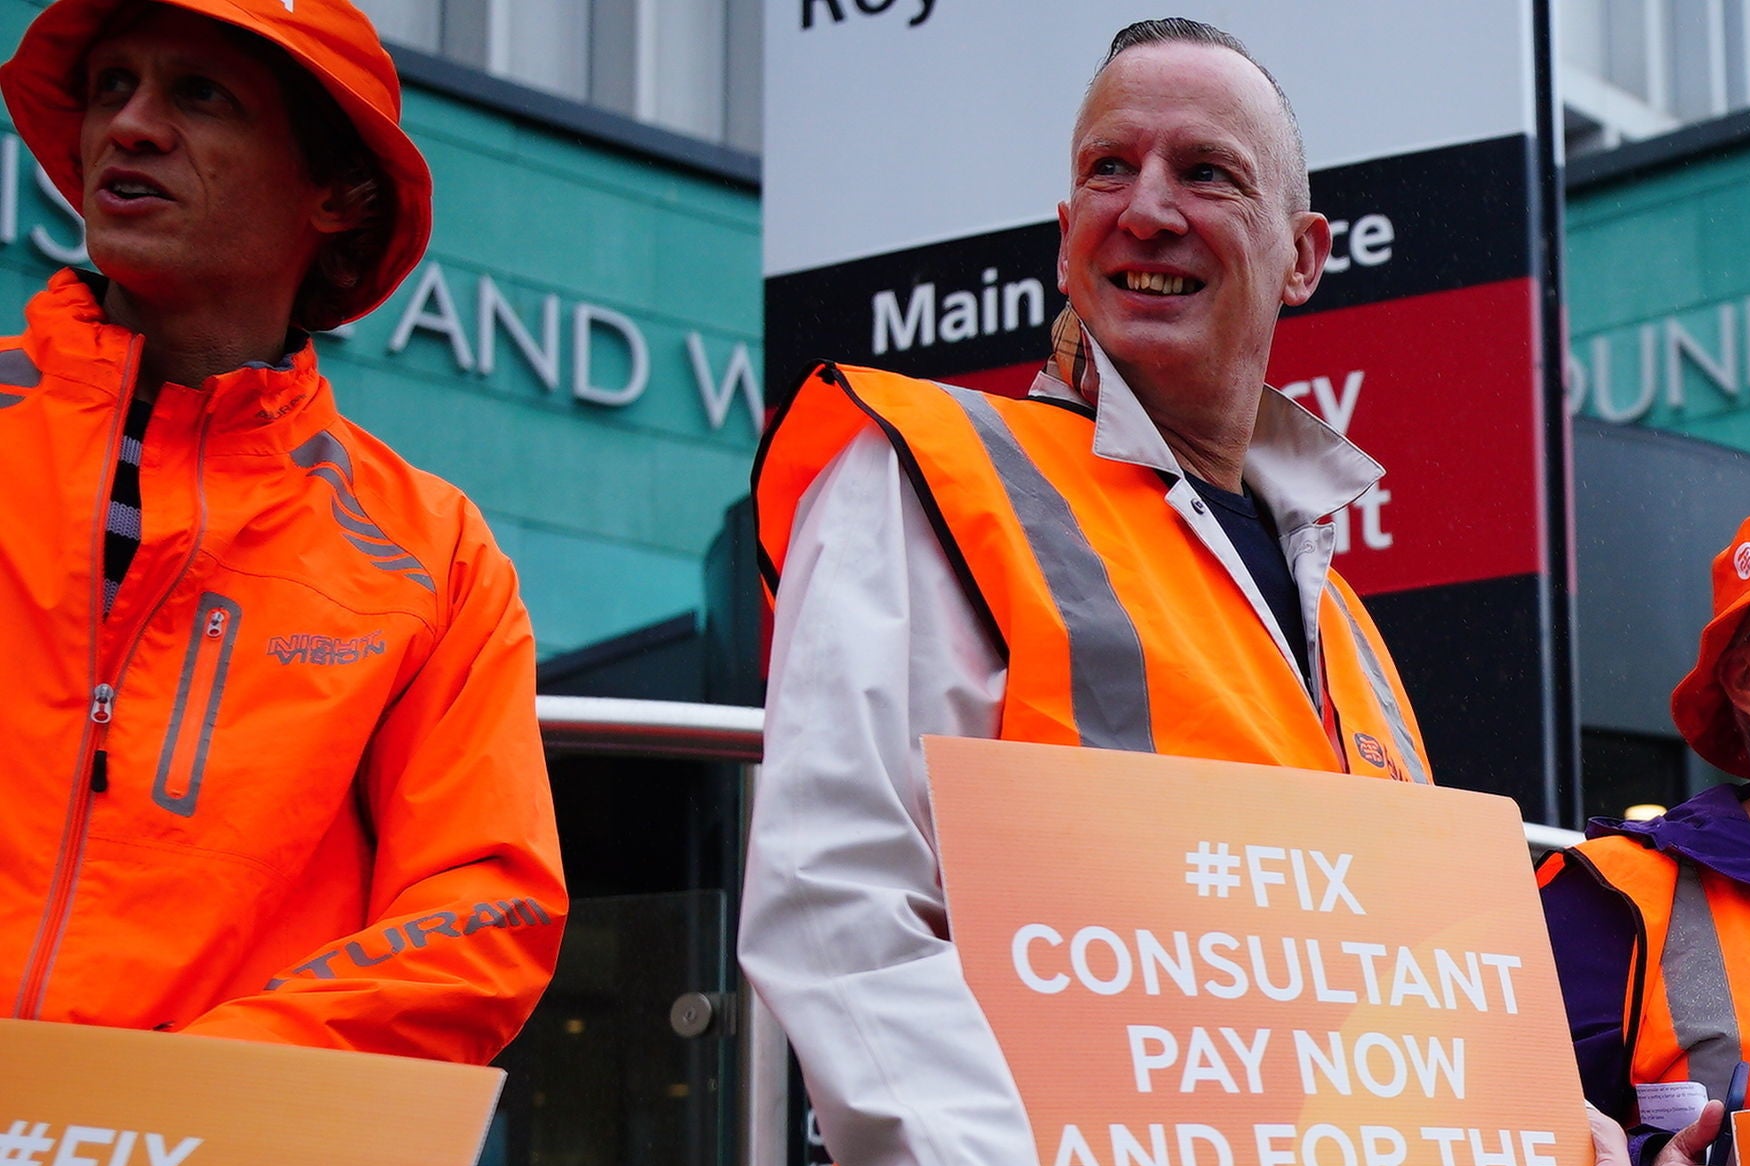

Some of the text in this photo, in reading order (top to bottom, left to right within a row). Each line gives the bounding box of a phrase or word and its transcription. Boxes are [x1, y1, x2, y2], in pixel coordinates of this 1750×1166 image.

[390, 262, 650, 405] AND
[873, 267, 1045, 355] Main
[1185, 840, 1366, 915] #FIX
[1011, 924, 1522, 1015] CONSULTANT
[1126, 1025, 1466, 1099] PAY NOW
